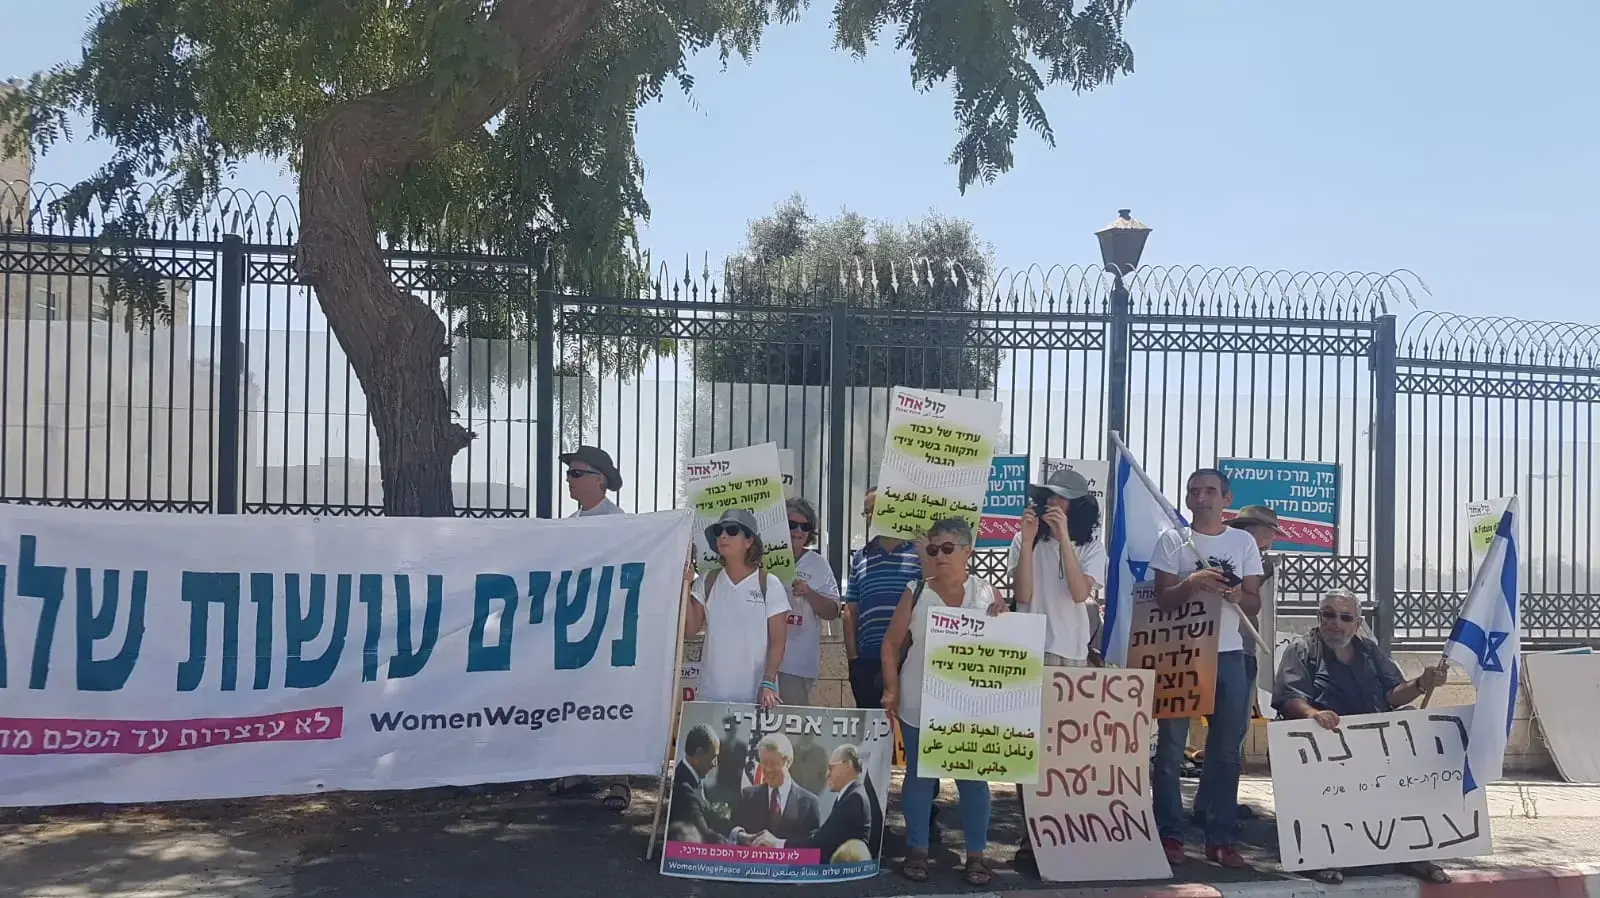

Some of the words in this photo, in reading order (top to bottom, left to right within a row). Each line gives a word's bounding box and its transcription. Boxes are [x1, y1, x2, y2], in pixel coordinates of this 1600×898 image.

[909, 423, 933, 435] כבוד
[937, 425, 953, 437] של
[893, 435, 915, 446] צידי
[956, 432, 981, 443] עתיד
[917, 440, 941, 452] בשני
[944, 444, 978, 457] ותקווה
[925, 453, 955, 467] הגבול
[1223, 465, 1274, 480] ושמאל
[1277, 470, 1309, 482] מרכז
[1312, 471, 1335, 486] מין,
[728, 480, 743, 491] של
[745, 476, 768, 487] עתיד
[987, 480, 1025, 491] דורשו
[705, 485, 727, 495] כבוד
[716, 496, 738, 507] בשני
[740, 490, 770, 504] ותקווה
[922, 494, 947, 506] الحياة
[991, 495, 1025, 507] הסכם
[695, 501, 714, 511] צידי
[949, 501, 978, 512] ضمان
[466, 562, 646, 673] נשים
[176, 572, 443, 692] עושות
[1132, 620, 1214, 647] ושדרות
[948, 644, 974, 656] כבוד
[978, 644, 995, 657] של
[998, 648, 1027, 661] עתיד
[1141, 644, 1200, 670] ילדים
[932, 660, 954, 670] צידי
[958, 663, 984, 673] בשני
[988, 664, 1026, 677] ותקווה
[969, 676, 1003, 689] הגבול
[1156, 670, 1198, 690] רוצי
[370, 701, 633, 731] WomenWagePeace
[295, 711, 331, 735] לא
[832, 716, 860, 737] זה
[929, 718, 965, 735] الكريمة
[180, 719, 285, 746] עוצרות
[970, 722, 999, 738] الحياة
[1003, 726, 1035, 740] ضمان
[43, 728, 120, 749] הסכם
[131, 727, 169, 750] עד
[923, 738, 943, 754] على
[948, 741, 977, 754] للناس
[982, 743, 1000, 754] ذلك
[941, 760, 974, 772] الحدود
[710, 848, 735, 857] הסכם
[737, 849, 750, 860] עד
[751, 850, 786, 861] עוצרות
[787, 850, 800, 860] לא
[668, 861, 741, 875] WomenWagePeace
